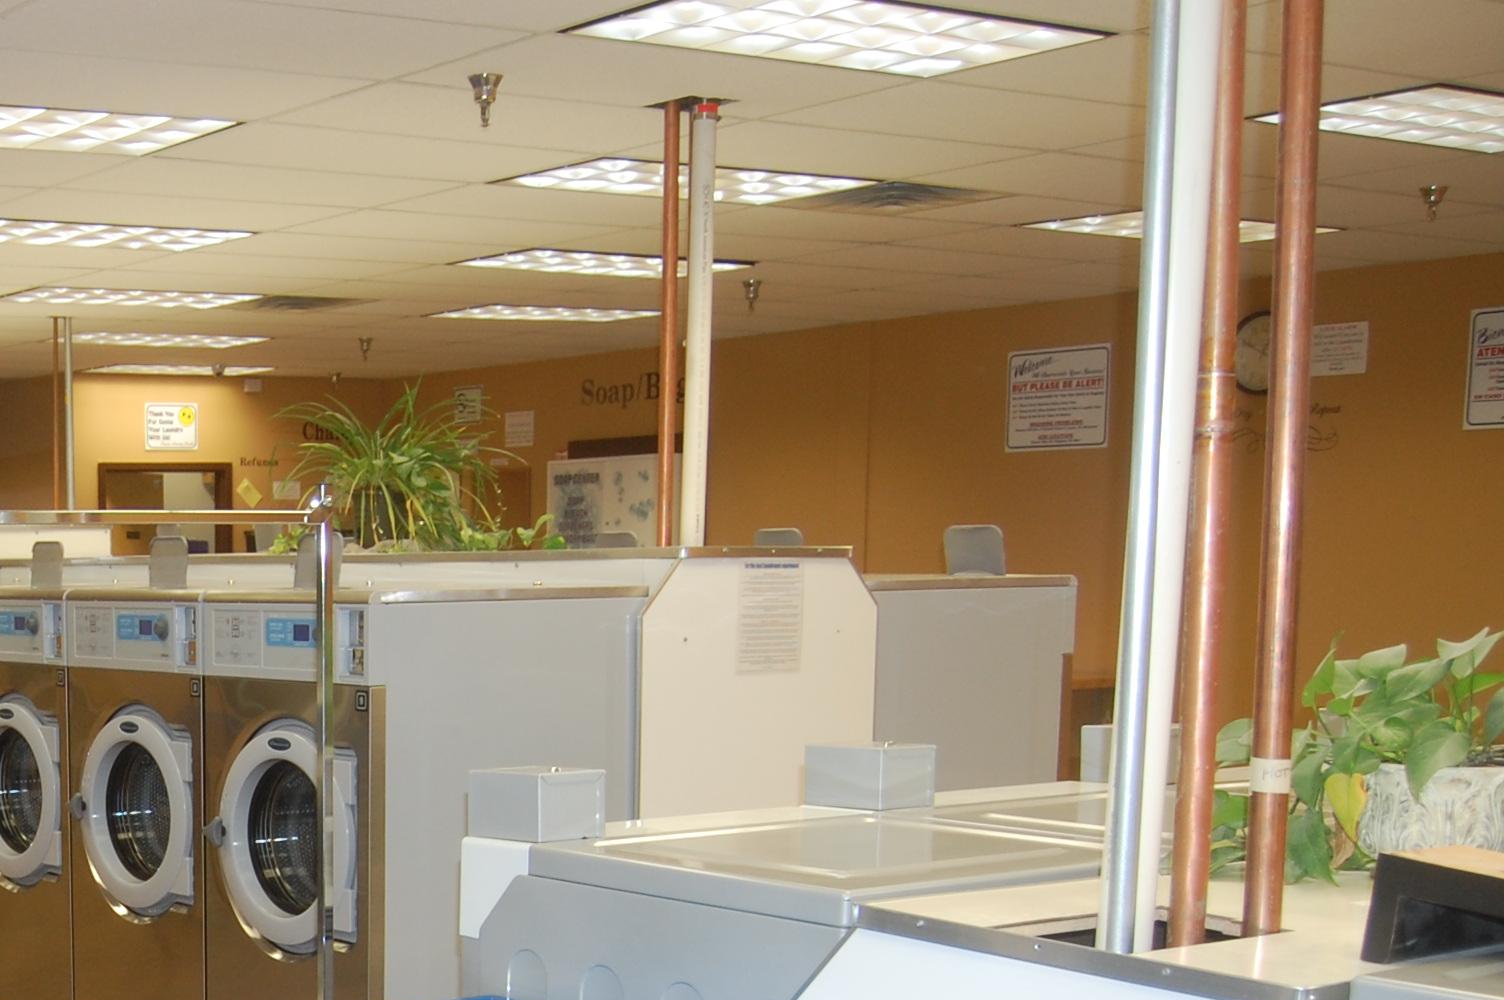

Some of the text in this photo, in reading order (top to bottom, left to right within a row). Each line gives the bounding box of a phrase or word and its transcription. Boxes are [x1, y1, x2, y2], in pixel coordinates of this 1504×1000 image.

[1012, 382, 1028, 393] BUT
[1029, 380, 1061, 391] PLEASE
[1062, 379, 1074, 389] BE
